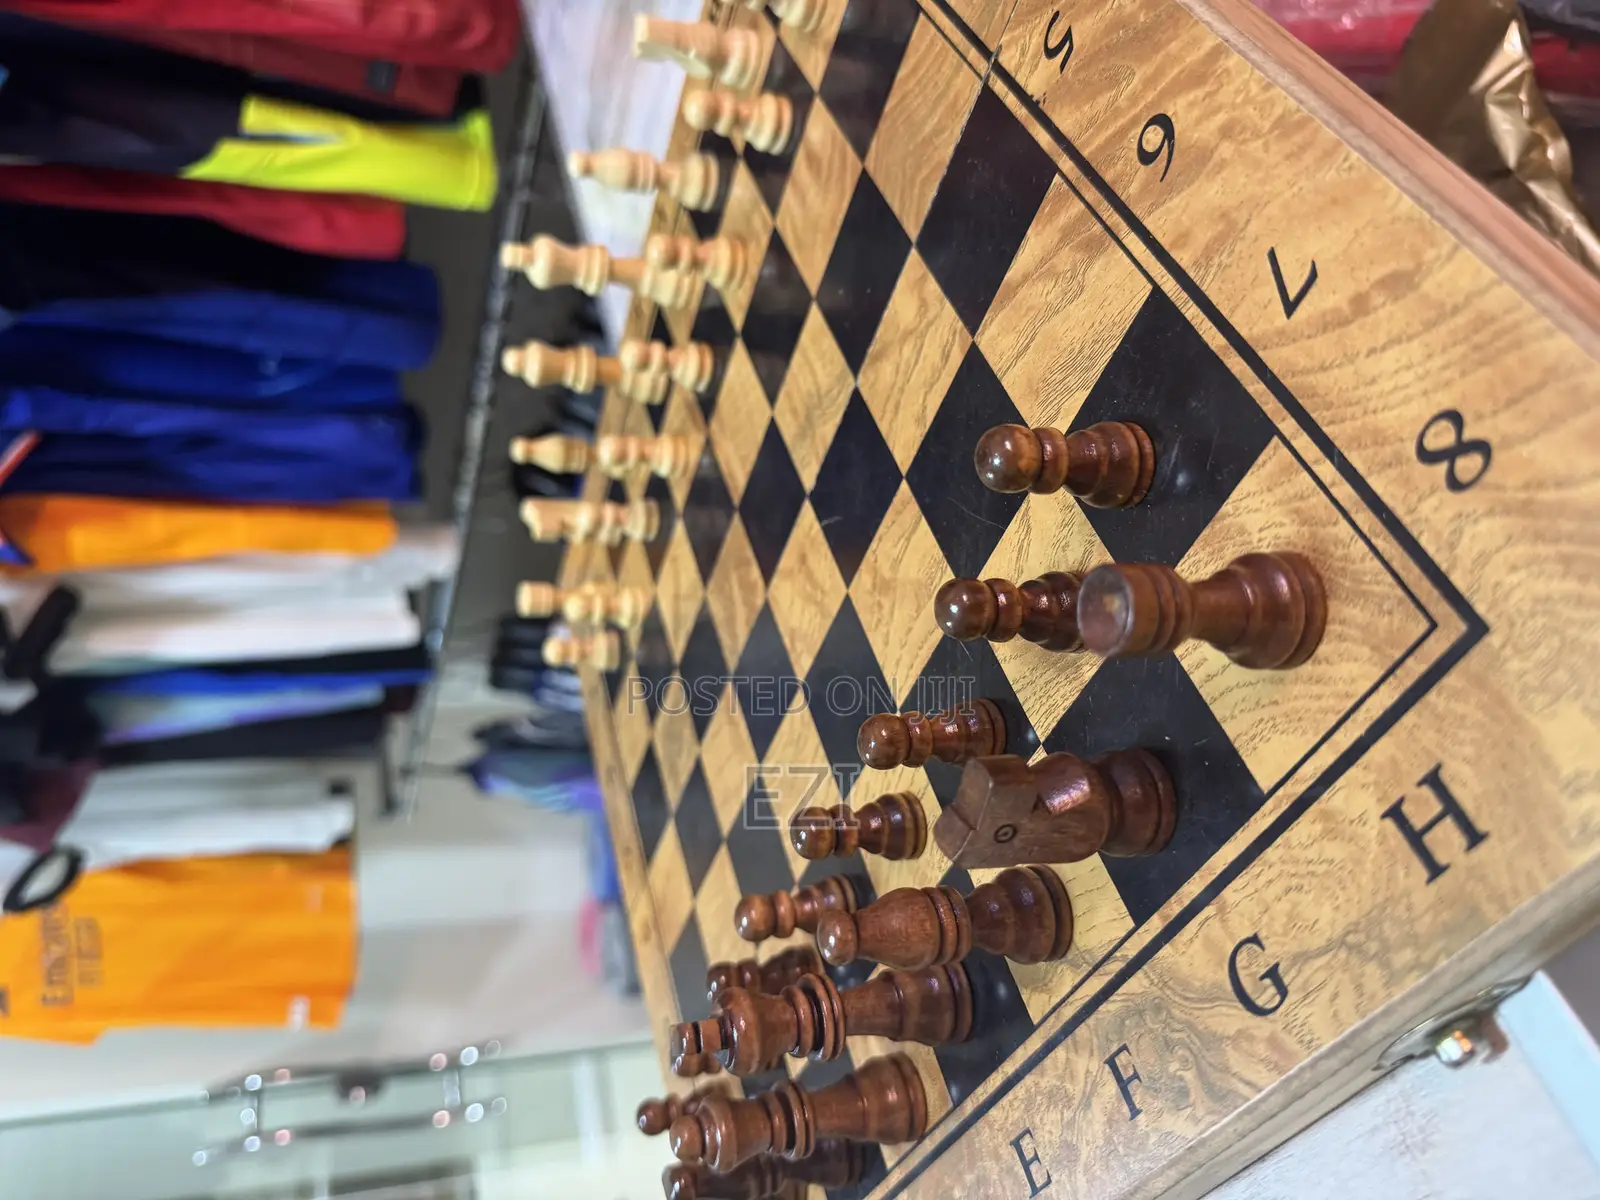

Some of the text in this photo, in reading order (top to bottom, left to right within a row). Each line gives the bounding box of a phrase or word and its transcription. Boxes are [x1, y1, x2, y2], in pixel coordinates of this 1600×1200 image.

[1043, 10, 1074, 74] 5
[1136, 113, 1175, 183] 6
[1268, 246, 1318, 320] 7
[1416, 410, 1492, 492] 8
[1381, 763, 1488, 884] H
[1228, 932, 1289, 1017] G
[1103, 1043, 1143, 1121] F
[1009, 1126, 1052, 1199] E
